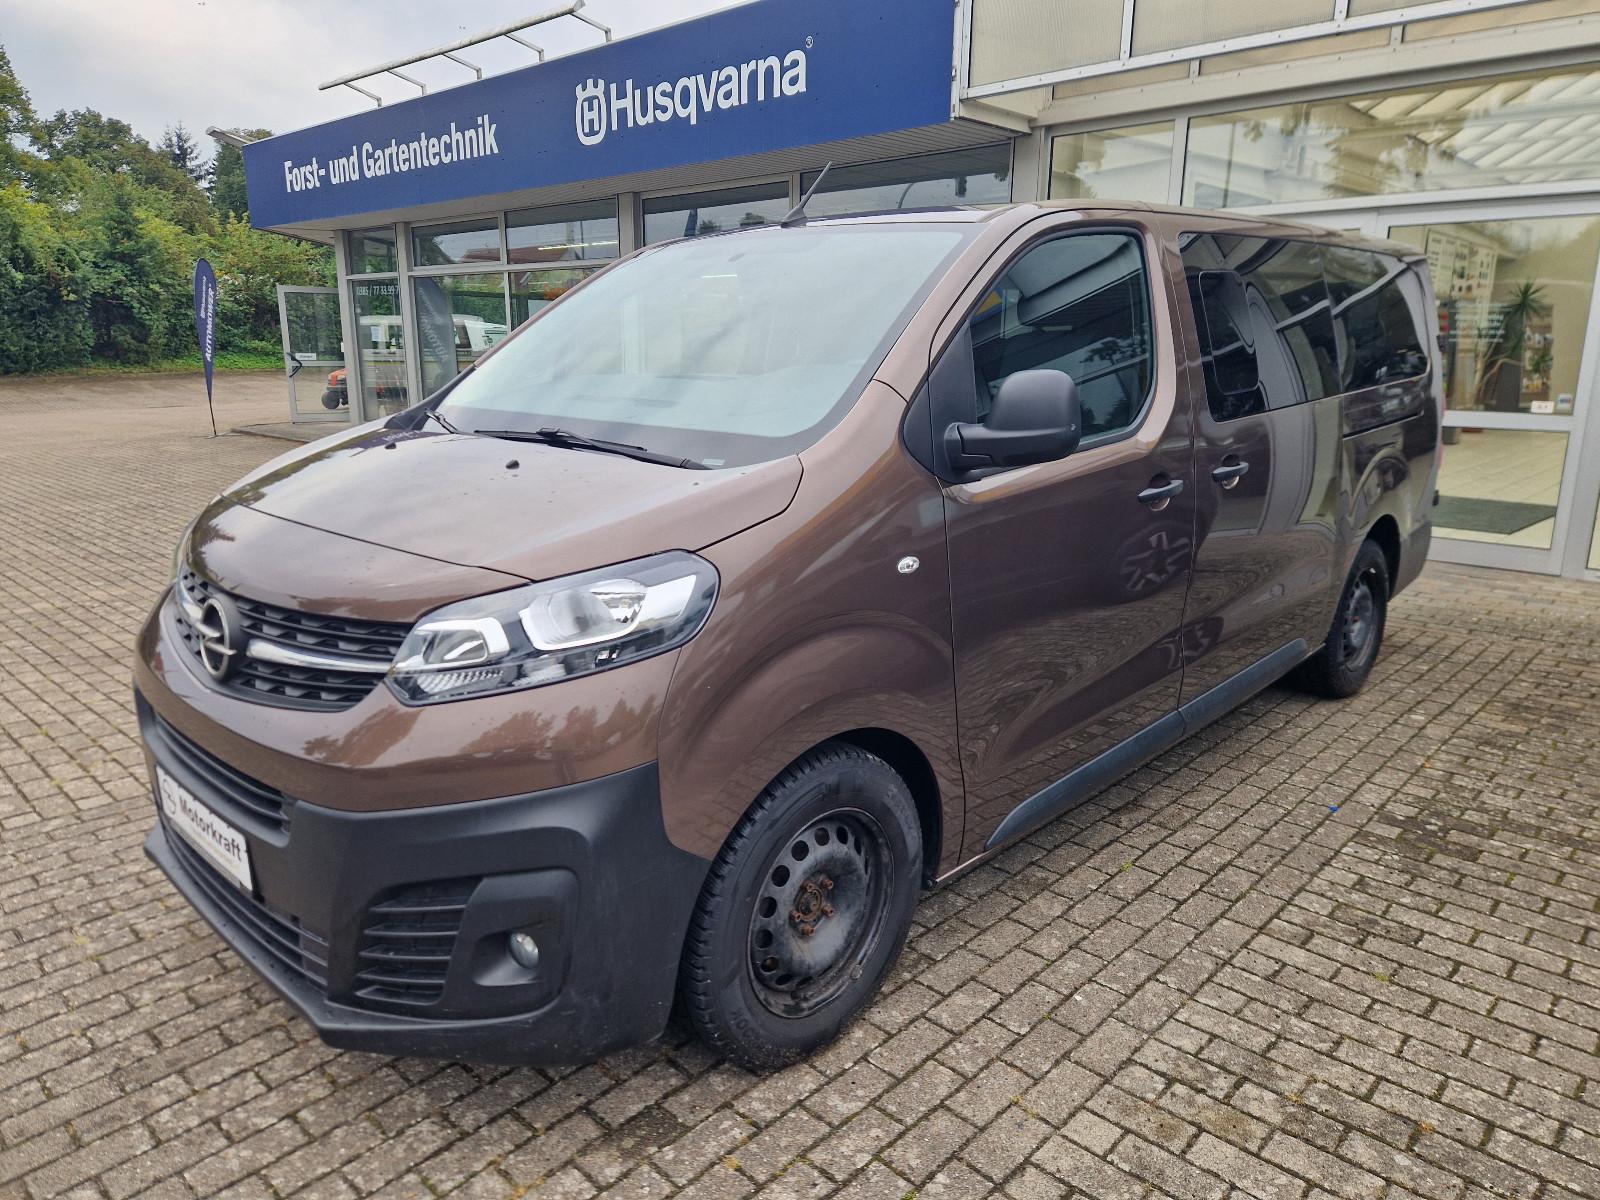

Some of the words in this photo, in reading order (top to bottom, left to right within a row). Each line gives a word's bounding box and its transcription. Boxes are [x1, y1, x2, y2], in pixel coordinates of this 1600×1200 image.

[609, 49, 807, 131] Husqvarna
[284, 157, 326, 193] Forst-
[328, 145, 360, 185] und
[362, 113, 499, 179] Gartentechnik
[179, 795, 242, 862] Motorkraft
